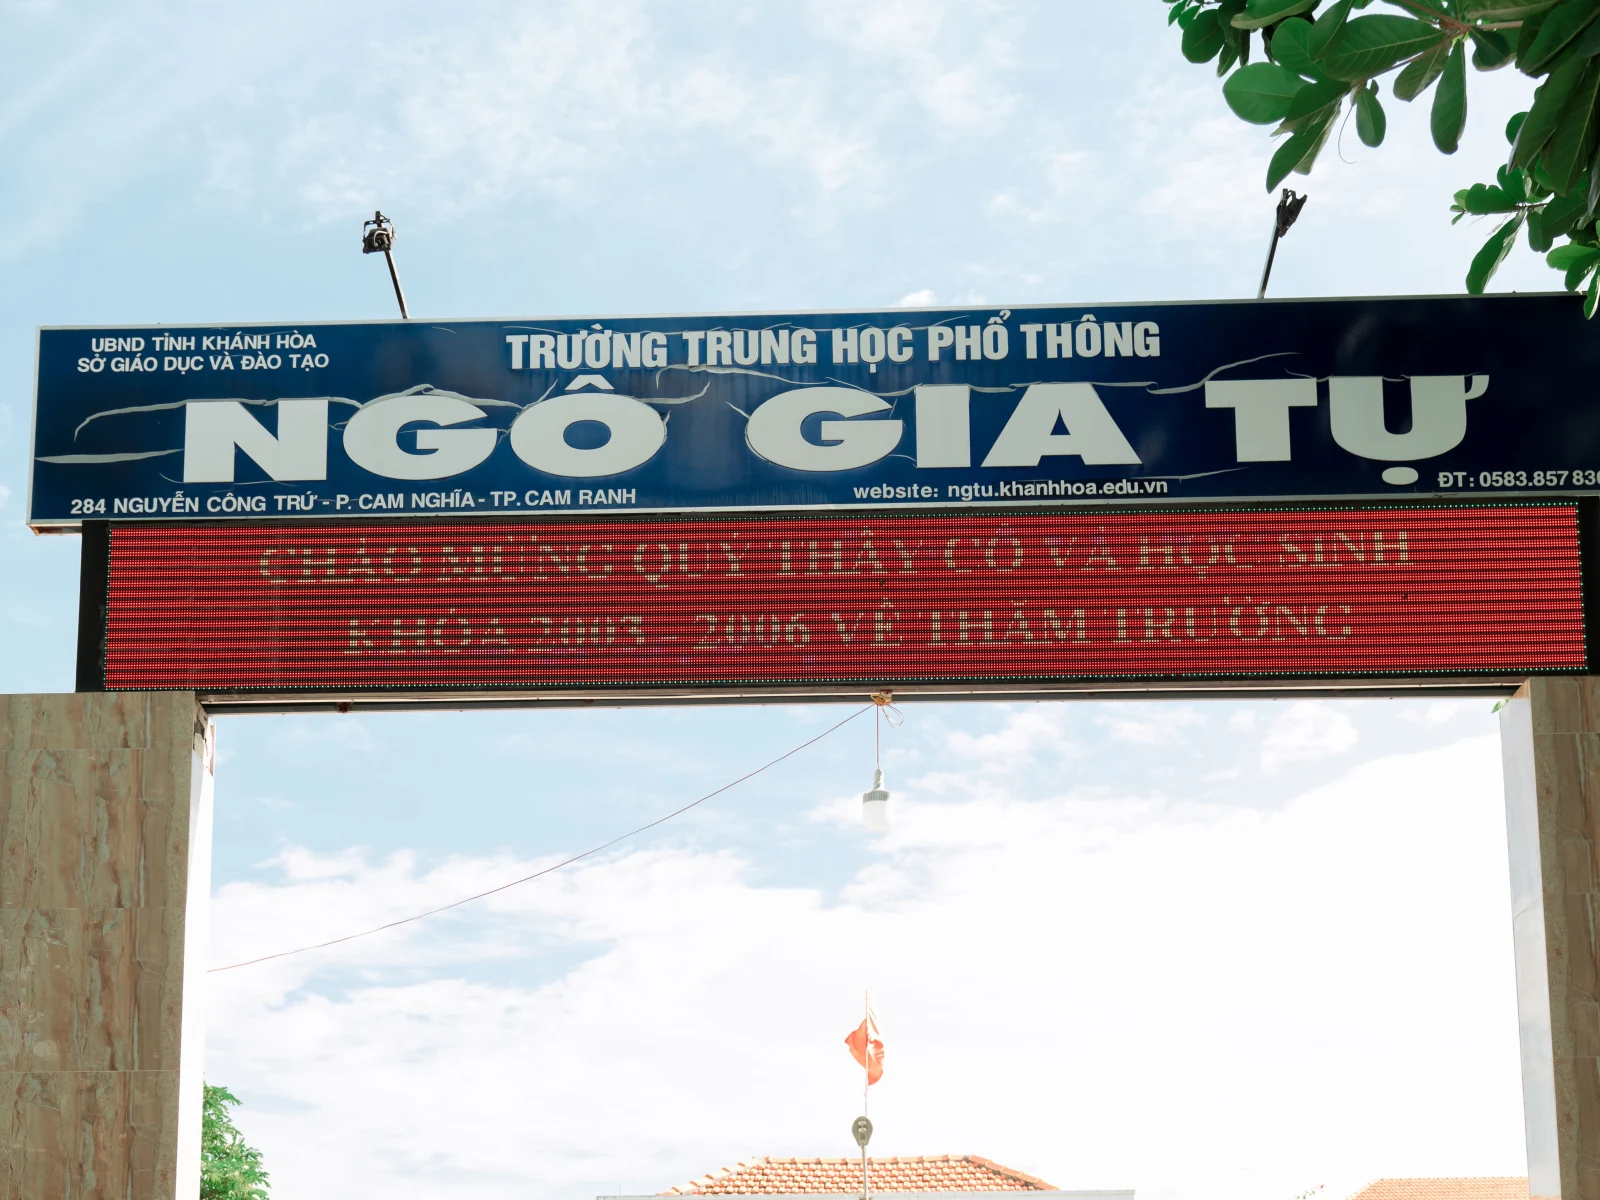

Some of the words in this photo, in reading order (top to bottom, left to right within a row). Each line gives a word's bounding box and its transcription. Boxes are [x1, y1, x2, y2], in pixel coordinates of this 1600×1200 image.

[91, 337, 145, 352] UBND
[152, 333, 196, 351] TỈNH
[202, 331, 270, 350] KHÁNH
[276, 330, 317, 349] HÒA
[505, 323, 668, 370] TRƯỜNG
[682, 328, 818, 366] TRUNG
[832, 326, 914, 373] HỌC
[927, 310, 1012, 362] PHỔ
[1020, 314, 1161, 359] THÔNG
[77, 354, 105, 372] SỞ
[110, 352, 158, 372] GIÁO
[164, 356, 204, 375] DỤC
[209, 352, 235, 370] VÀ
[241, 351, 282, 370] ĐÀO
[288, 353, 329, 371] TẠO
[183, 374, 668, 483] NGÔ
[745, 382, 1143, 473] GIA
[1205, 374, 1490, 486] TỰ
[70, 498, 106, 514] 284
[113, 491, 199, 514] NGUYỄN
[206, 493, 267, 513] CÔNG
[273, 491, 318, 511] TRỨ
[335, 494, 352, 510] P.
[358, 493, 404, 509] CAM
[411, 489, 475, 508] NGHĨA
[490, 491, 521, 507] TP.
[524, 490, 571, 506] CAM
[578, 488, 636, 505] RANH
[853, 482, 938, 498] website:
[947, 479, 1168, 501] ngtu.khanhhoa.edu.vn
[1278, 531, 1415, 567] SINH
[917, 599, 1091, 644] THĂM
